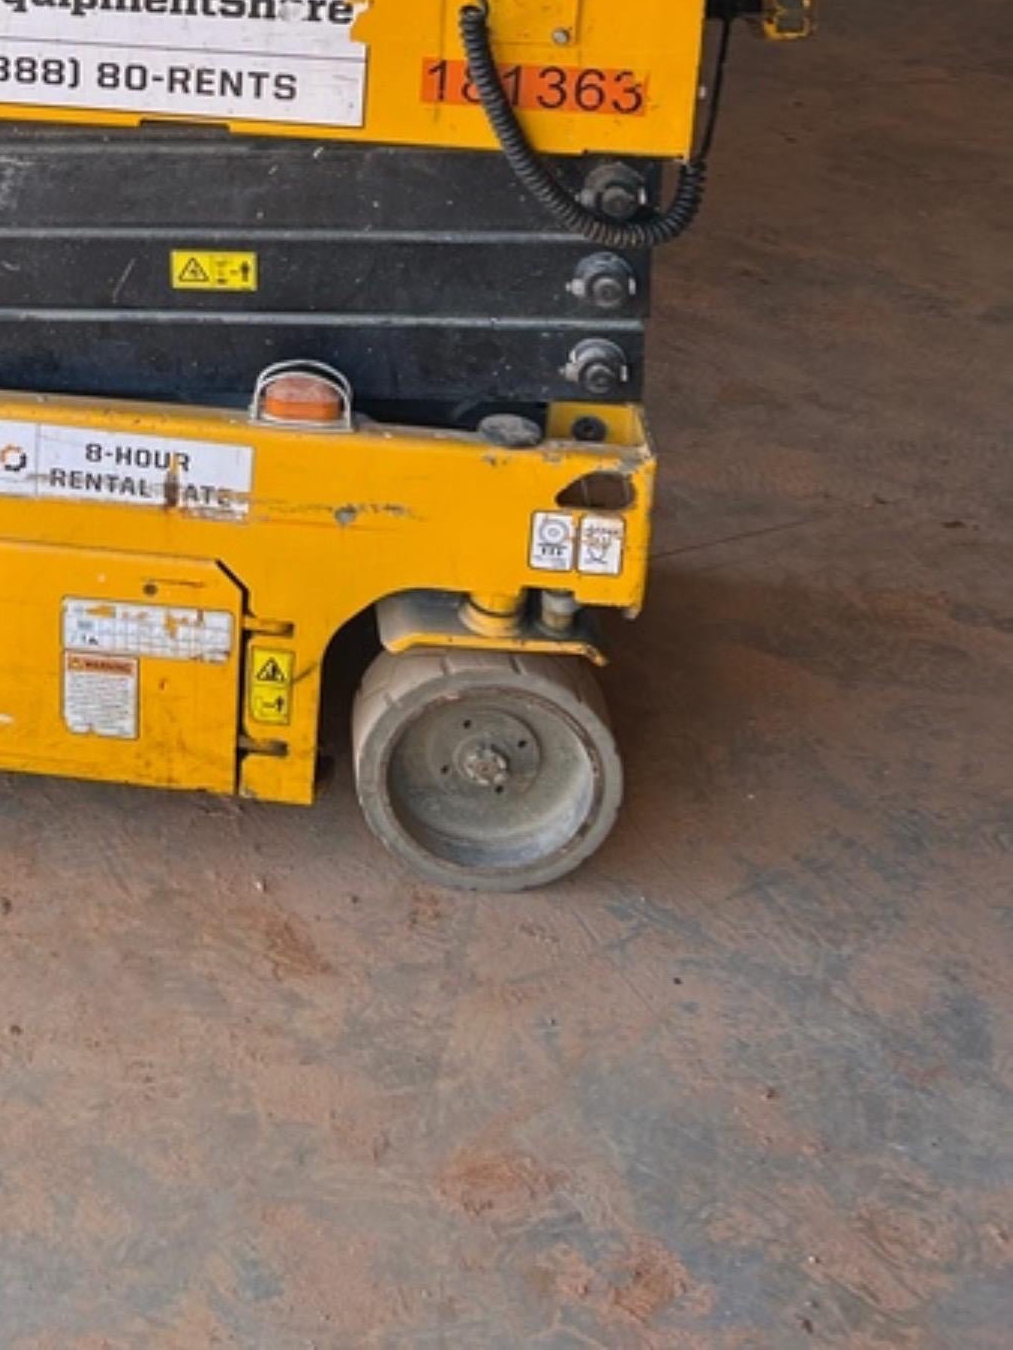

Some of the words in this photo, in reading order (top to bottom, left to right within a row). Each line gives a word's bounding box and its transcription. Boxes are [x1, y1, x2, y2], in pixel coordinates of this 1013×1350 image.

[96, 62, 298, 101] 80-RENTS
[85, 442, 191, 472] 8-HOUR
[49, 467, 153, 499] RENTAL
[165, 480, 233, 509] ATE
